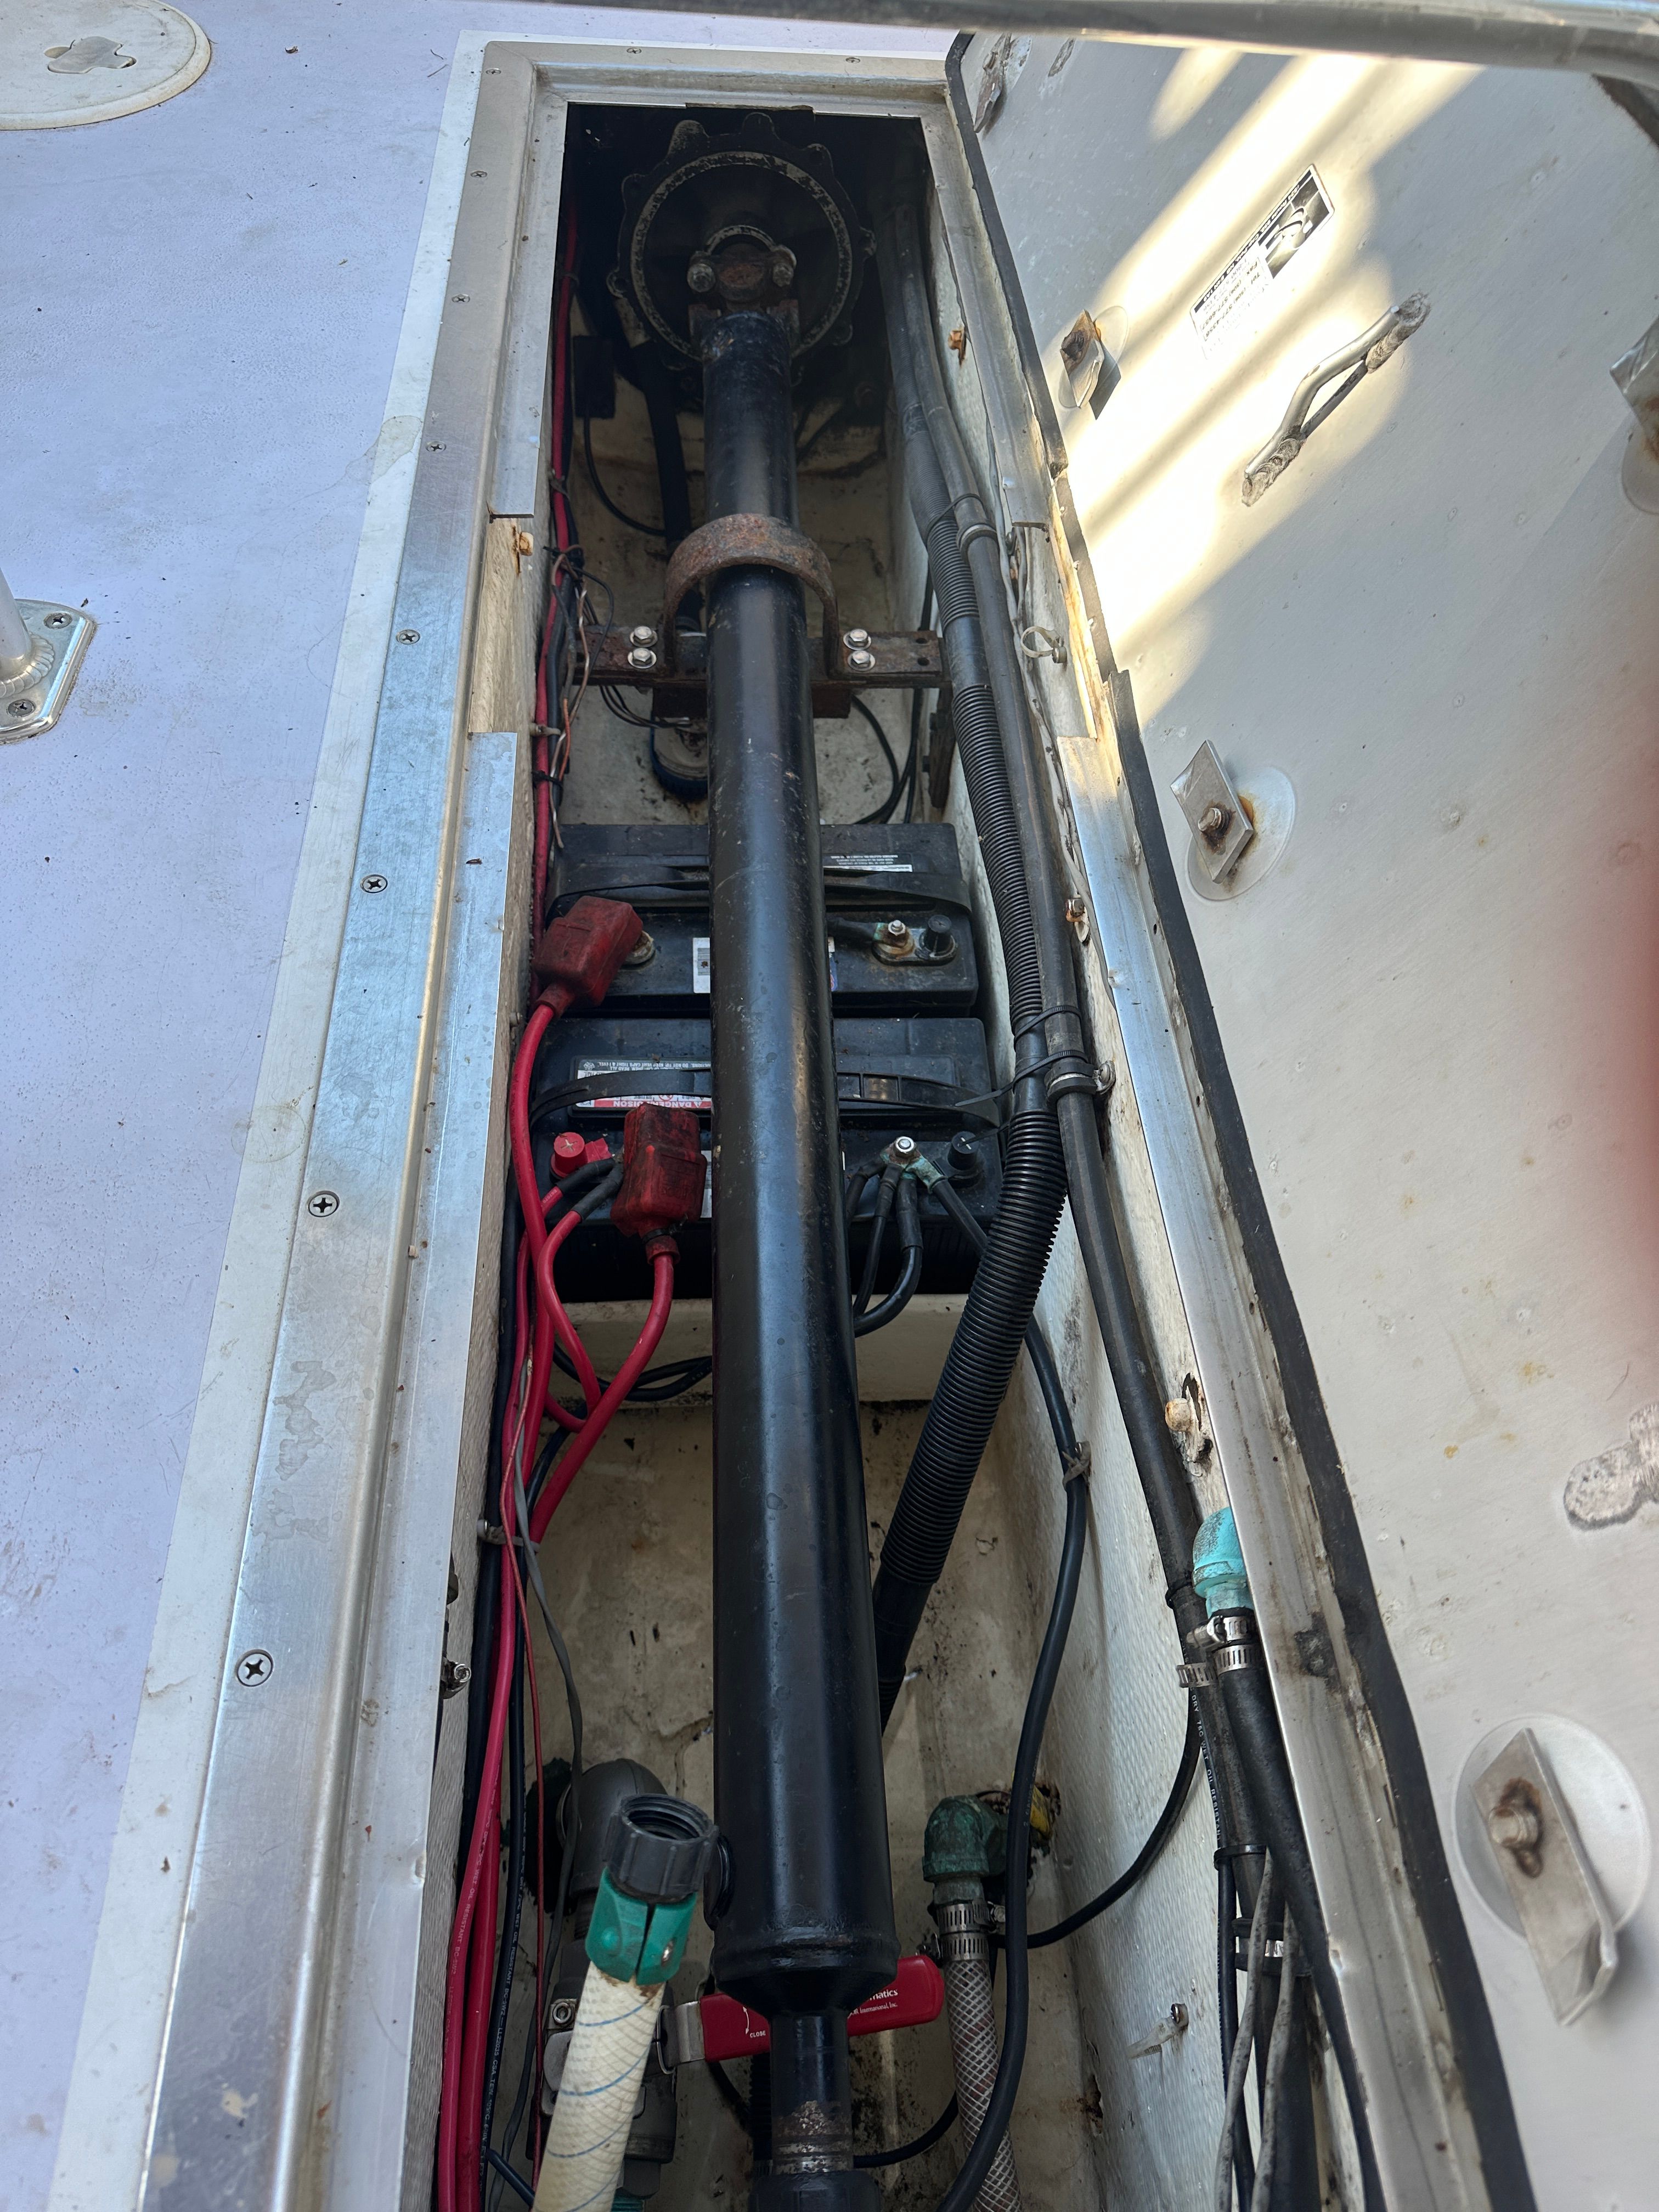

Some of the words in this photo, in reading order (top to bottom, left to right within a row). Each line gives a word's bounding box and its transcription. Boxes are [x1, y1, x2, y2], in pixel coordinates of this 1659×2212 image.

[1245, 260, 1258, 277] Fax
[1191, 1695, 1199, 1712] DRY
[456, 1904, 471, 1944] RESISTANT
[506, 1946, 516, 1985] RESISTANT
[749, 2030, 766, 2039] CLOSE
